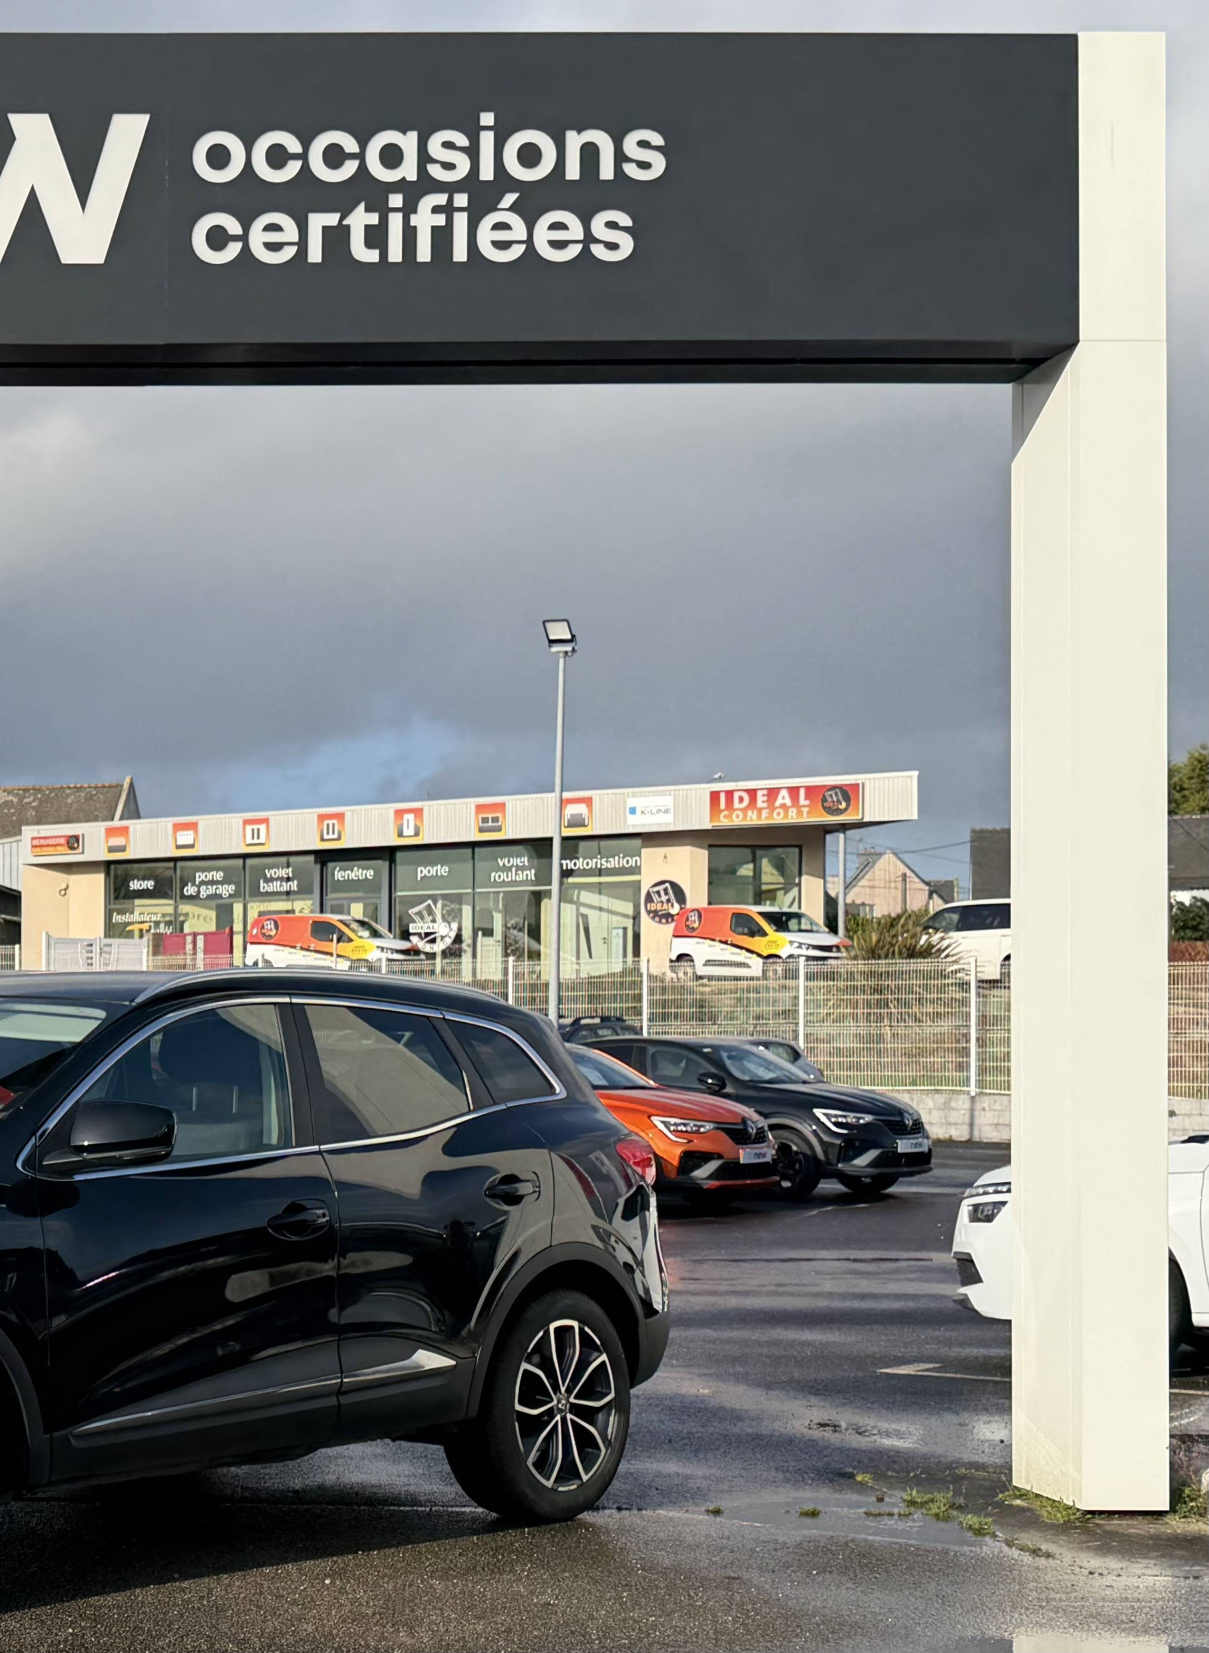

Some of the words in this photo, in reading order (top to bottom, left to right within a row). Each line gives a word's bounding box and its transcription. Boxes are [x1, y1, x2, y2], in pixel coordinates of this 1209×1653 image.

[191, 111, 667, 183] occasions
[191, 192, 635, 265] certifiées
[719, 787, 810, 810] IDEAL
[719, 807, 810, 822] CONFORT
[497, 855, 529, 867] volet
[195, 870, 224, 885] porte
[265, 867, 293, 878] volet
[334, 866, 374, 881] fenêtre
[417, 864, 449, 880] porte
[490, 867, 536, 882] roulant
[129, 879, 155, 891] store
[183, 882, 198, 896] de
[199, 883, 236, 899] garage
[259, 879, 298, 892] battant
[647, 902, 673, 911] IDEAL
